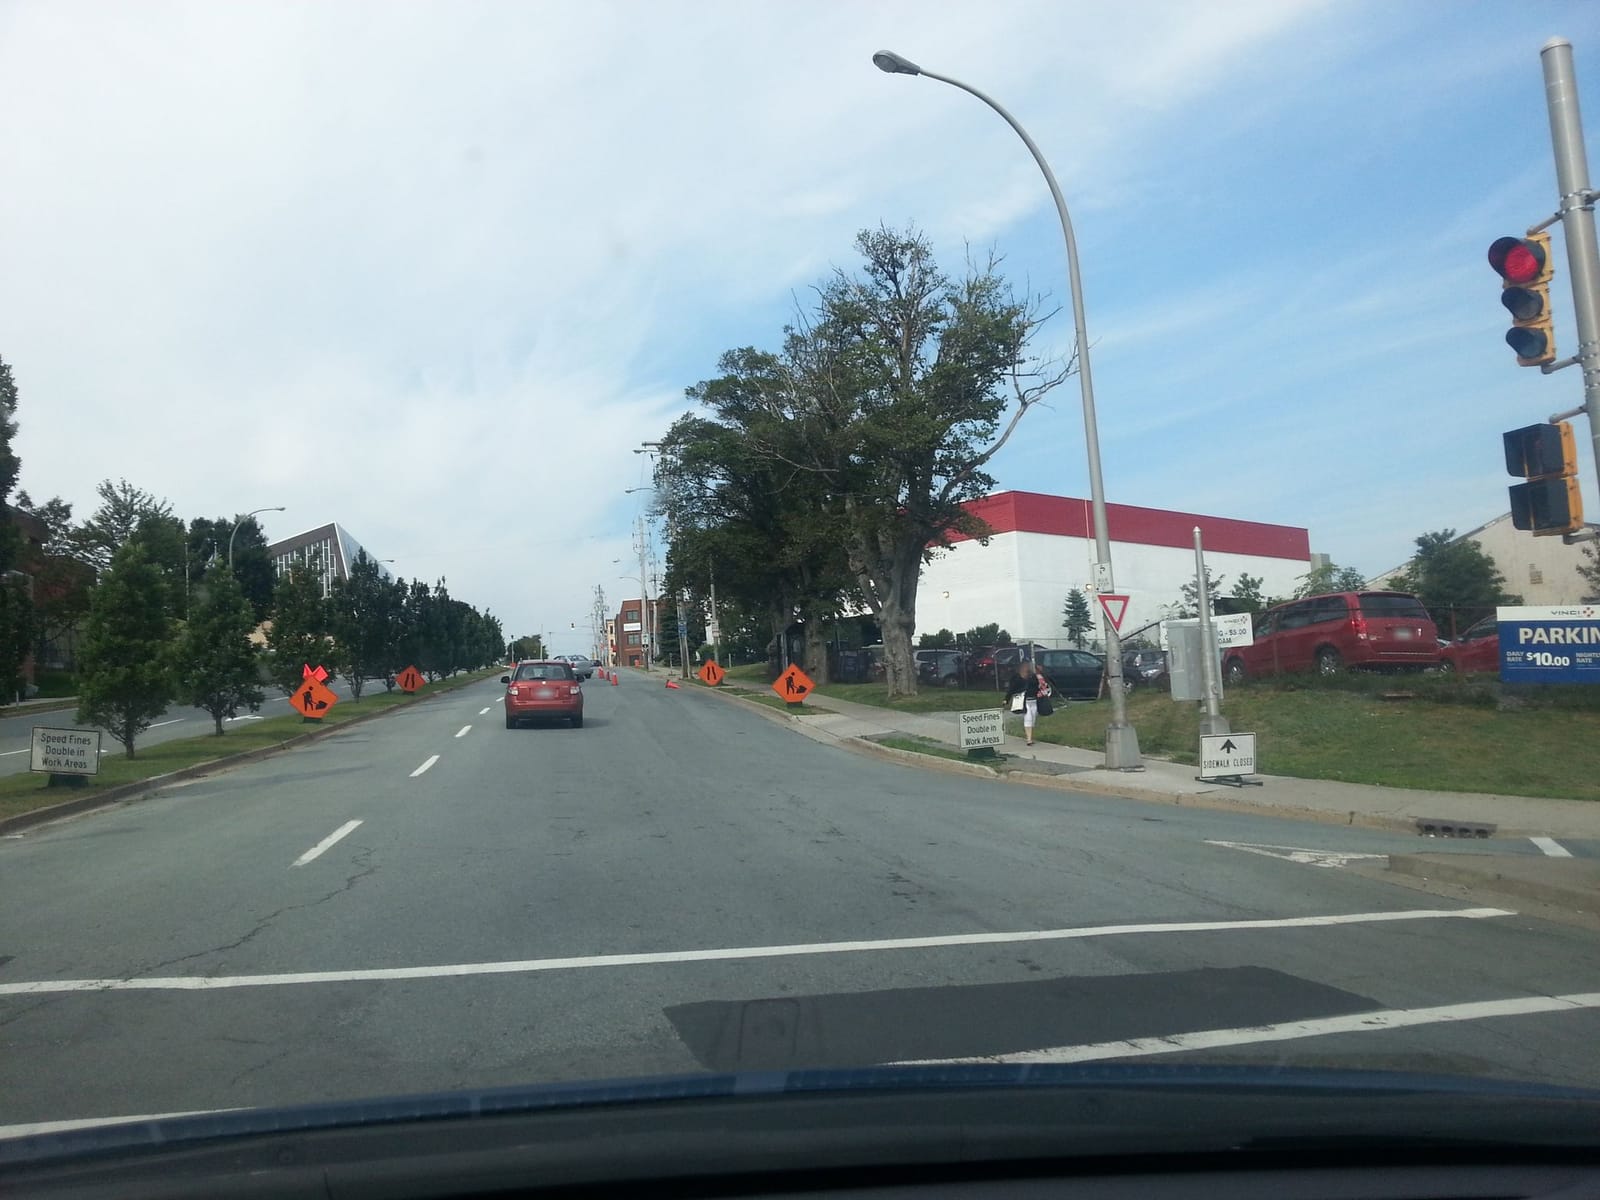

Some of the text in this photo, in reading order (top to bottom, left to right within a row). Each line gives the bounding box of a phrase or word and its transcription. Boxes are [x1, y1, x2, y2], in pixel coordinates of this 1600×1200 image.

[1526, 652, 1570, 666] $10.00
[962, 713, 1000, 724] Speed Fines
[967, 726, 990, 734] Double
[40, 732, 91, 745] Speed Fines
[965, 736, 1000, 746] Work Areas
[45, 745, 85, 757] Double in
[41, 757, 88, 769] Work Areas
[1203, 757, 1253, 769] SIDEWALK CLOSED
